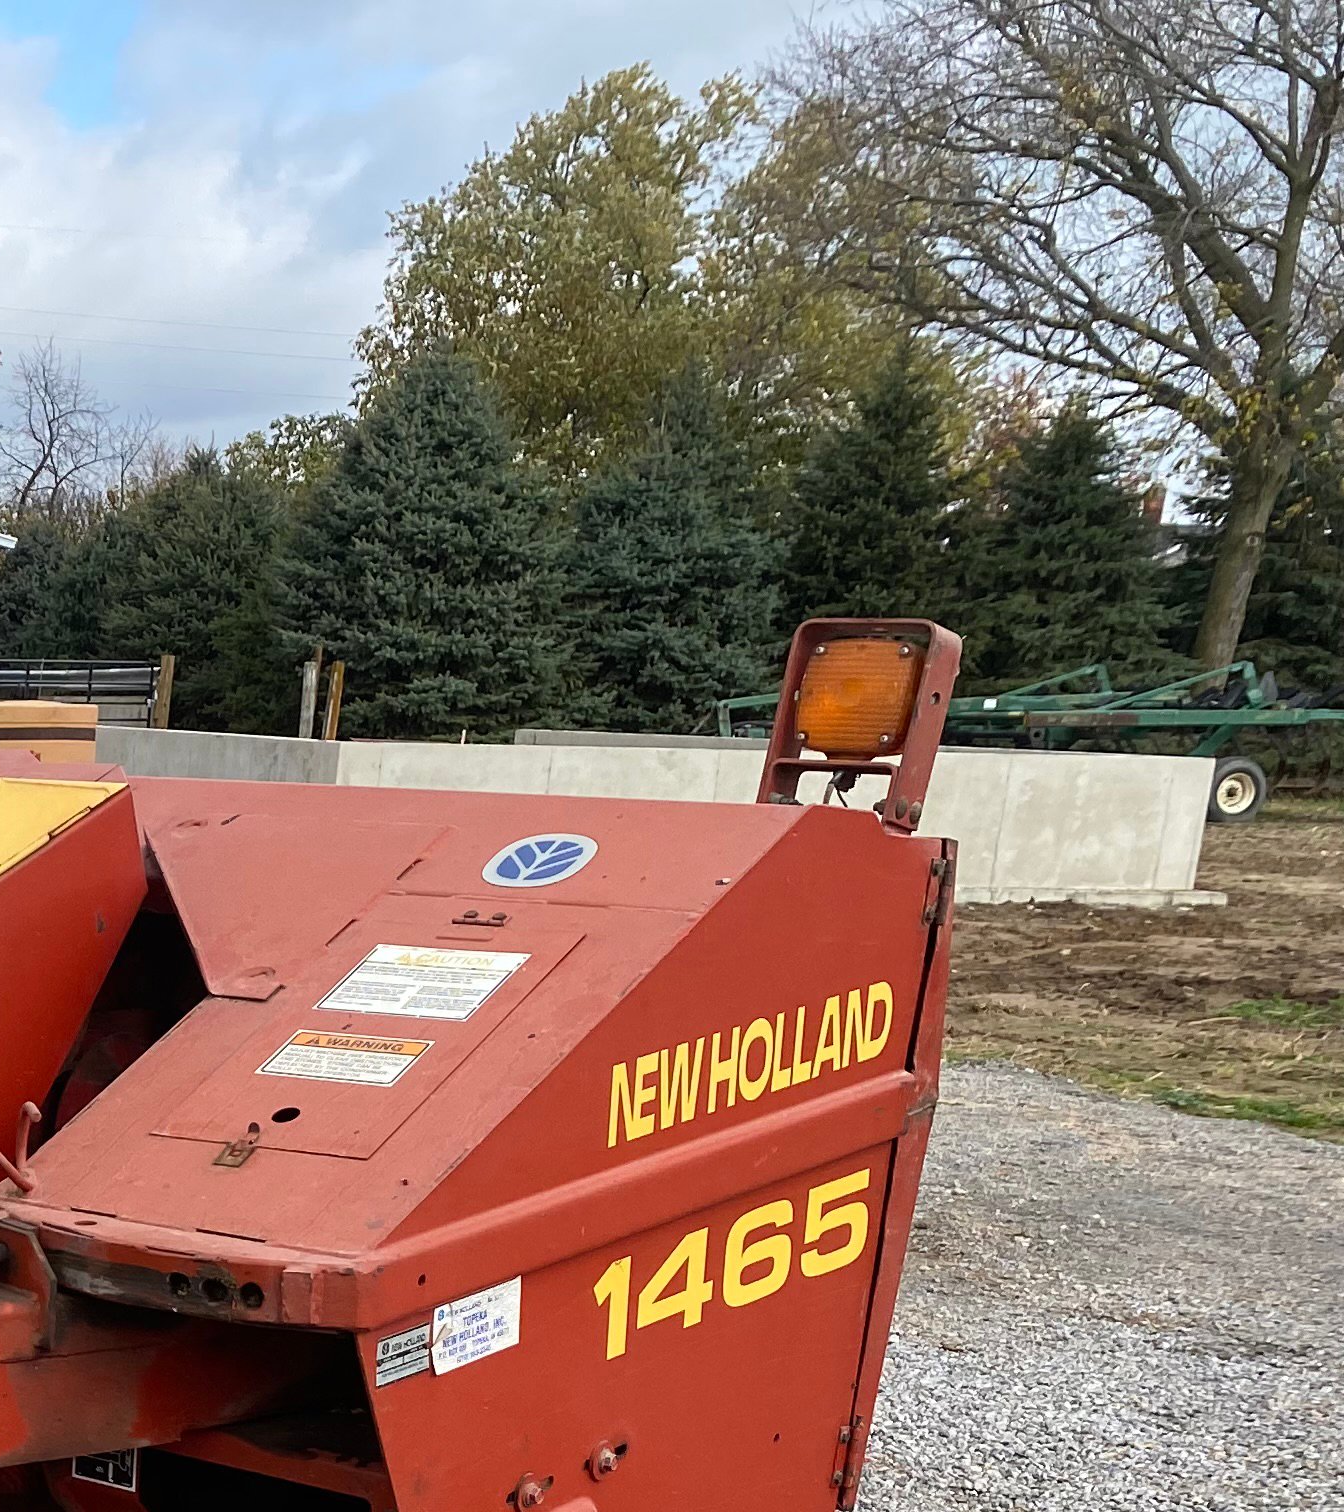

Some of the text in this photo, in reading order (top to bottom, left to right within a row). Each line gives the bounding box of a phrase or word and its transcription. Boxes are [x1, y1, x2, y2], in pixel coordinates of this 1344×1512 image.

[414, 953, 496, 967] CAUTION
[326, 1037, 404, 1052] WARNING
[607, 981, 893, 1149] NEW HOLLAND
[593, 1168, 870, 1361] 1465
[443, 1333, 458, 1347] NEW
